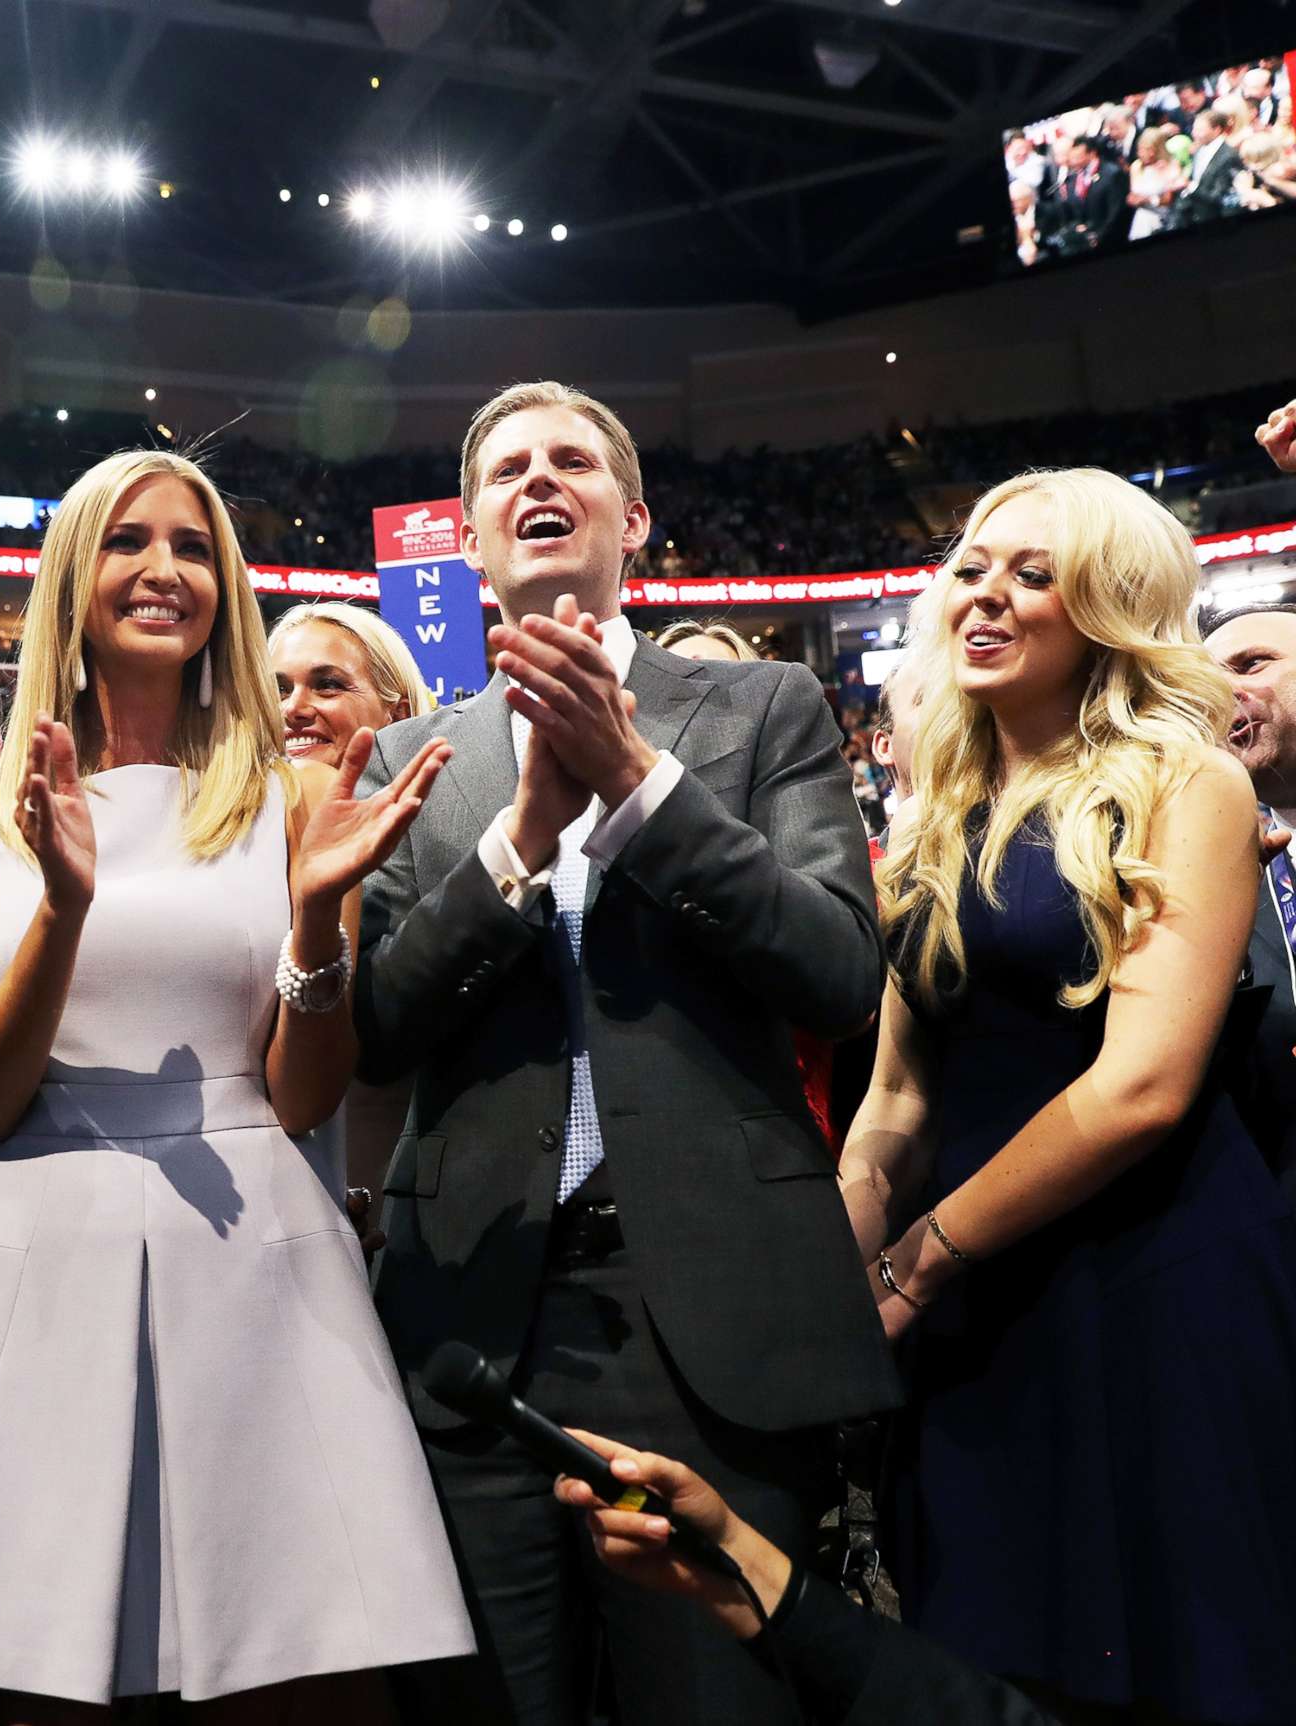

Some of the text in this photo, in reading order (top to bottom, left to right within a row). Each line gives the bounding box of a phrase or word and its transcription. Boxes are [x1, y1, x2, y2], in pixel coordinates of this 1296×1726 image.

[415, 566, 446, 644] NEW
[644, 584, 677, 602] We
[679, 583, 727, 601] must
[729, 581, 772, 600] take
[773, 583, 807, 598] our
[809, 577, 883, 598] country
